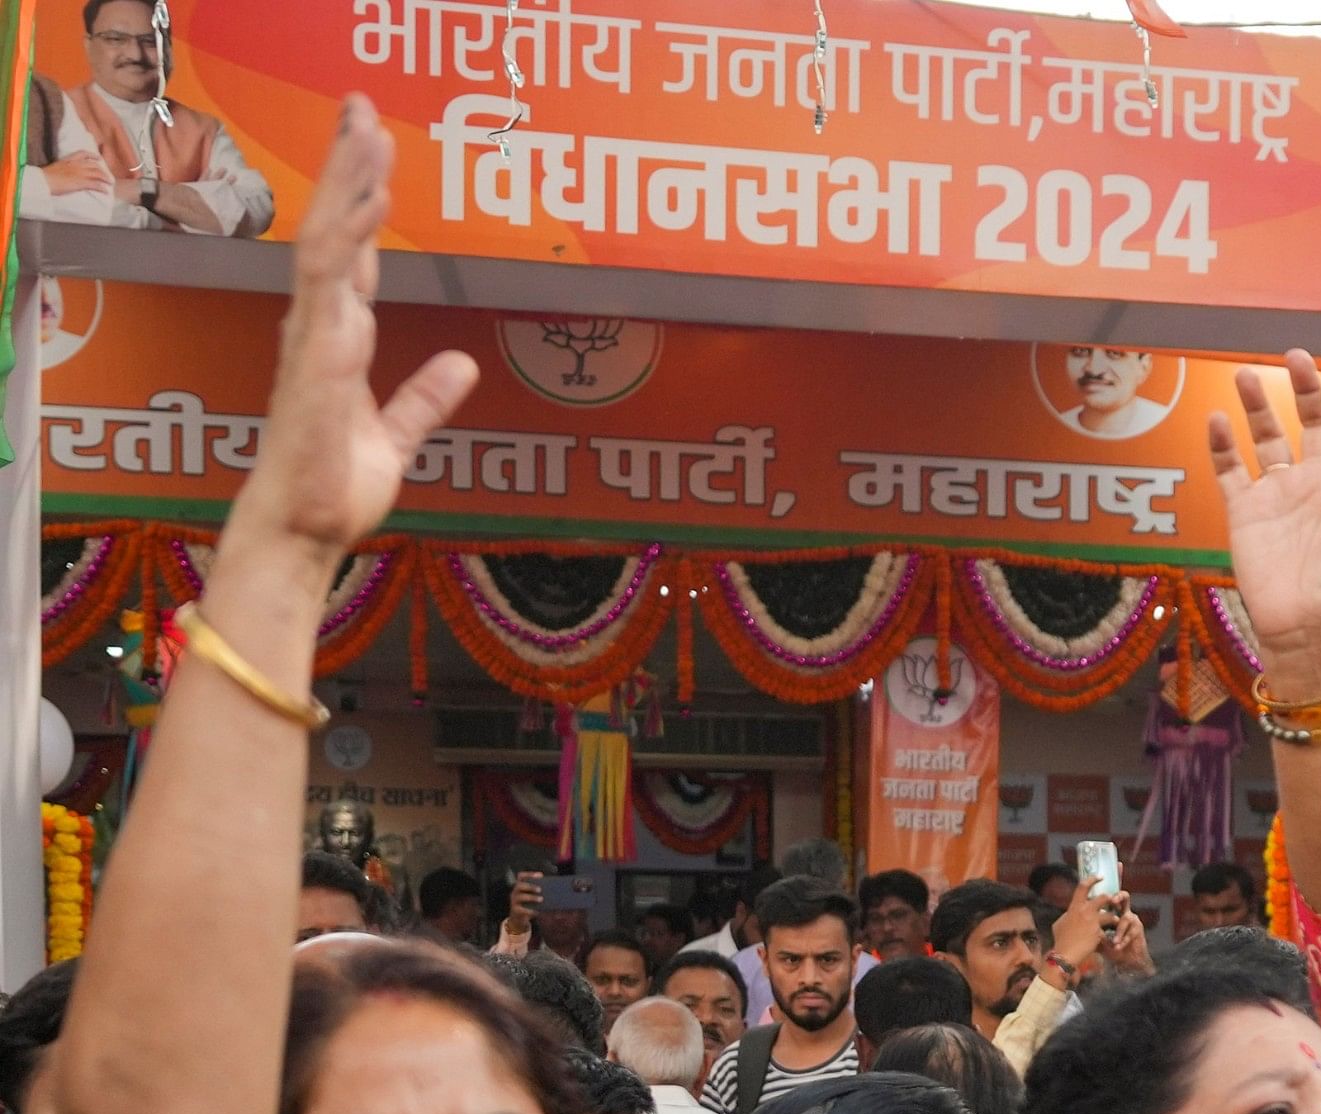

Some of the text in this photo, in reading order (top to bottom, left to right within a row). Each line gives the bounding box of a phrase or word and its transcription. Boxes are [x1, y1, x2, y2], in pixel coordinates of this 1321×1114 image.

[352, 0, 641, 94] भारतीय
[655, 21, 870, 113] जनता
[429, 94, 1218, 276] विधानसभा 2024
[41, 389, 270, 475] रतीय
[402, 427, 577, 497] नता
[839, 451, 1187, 535] महाराष्ट्र
[881, 775, 980, 804] जनता पार्टी
[895, 744, 968, 773] भारतीय
[894, 807, 967, 836] महाराष्ट्र
